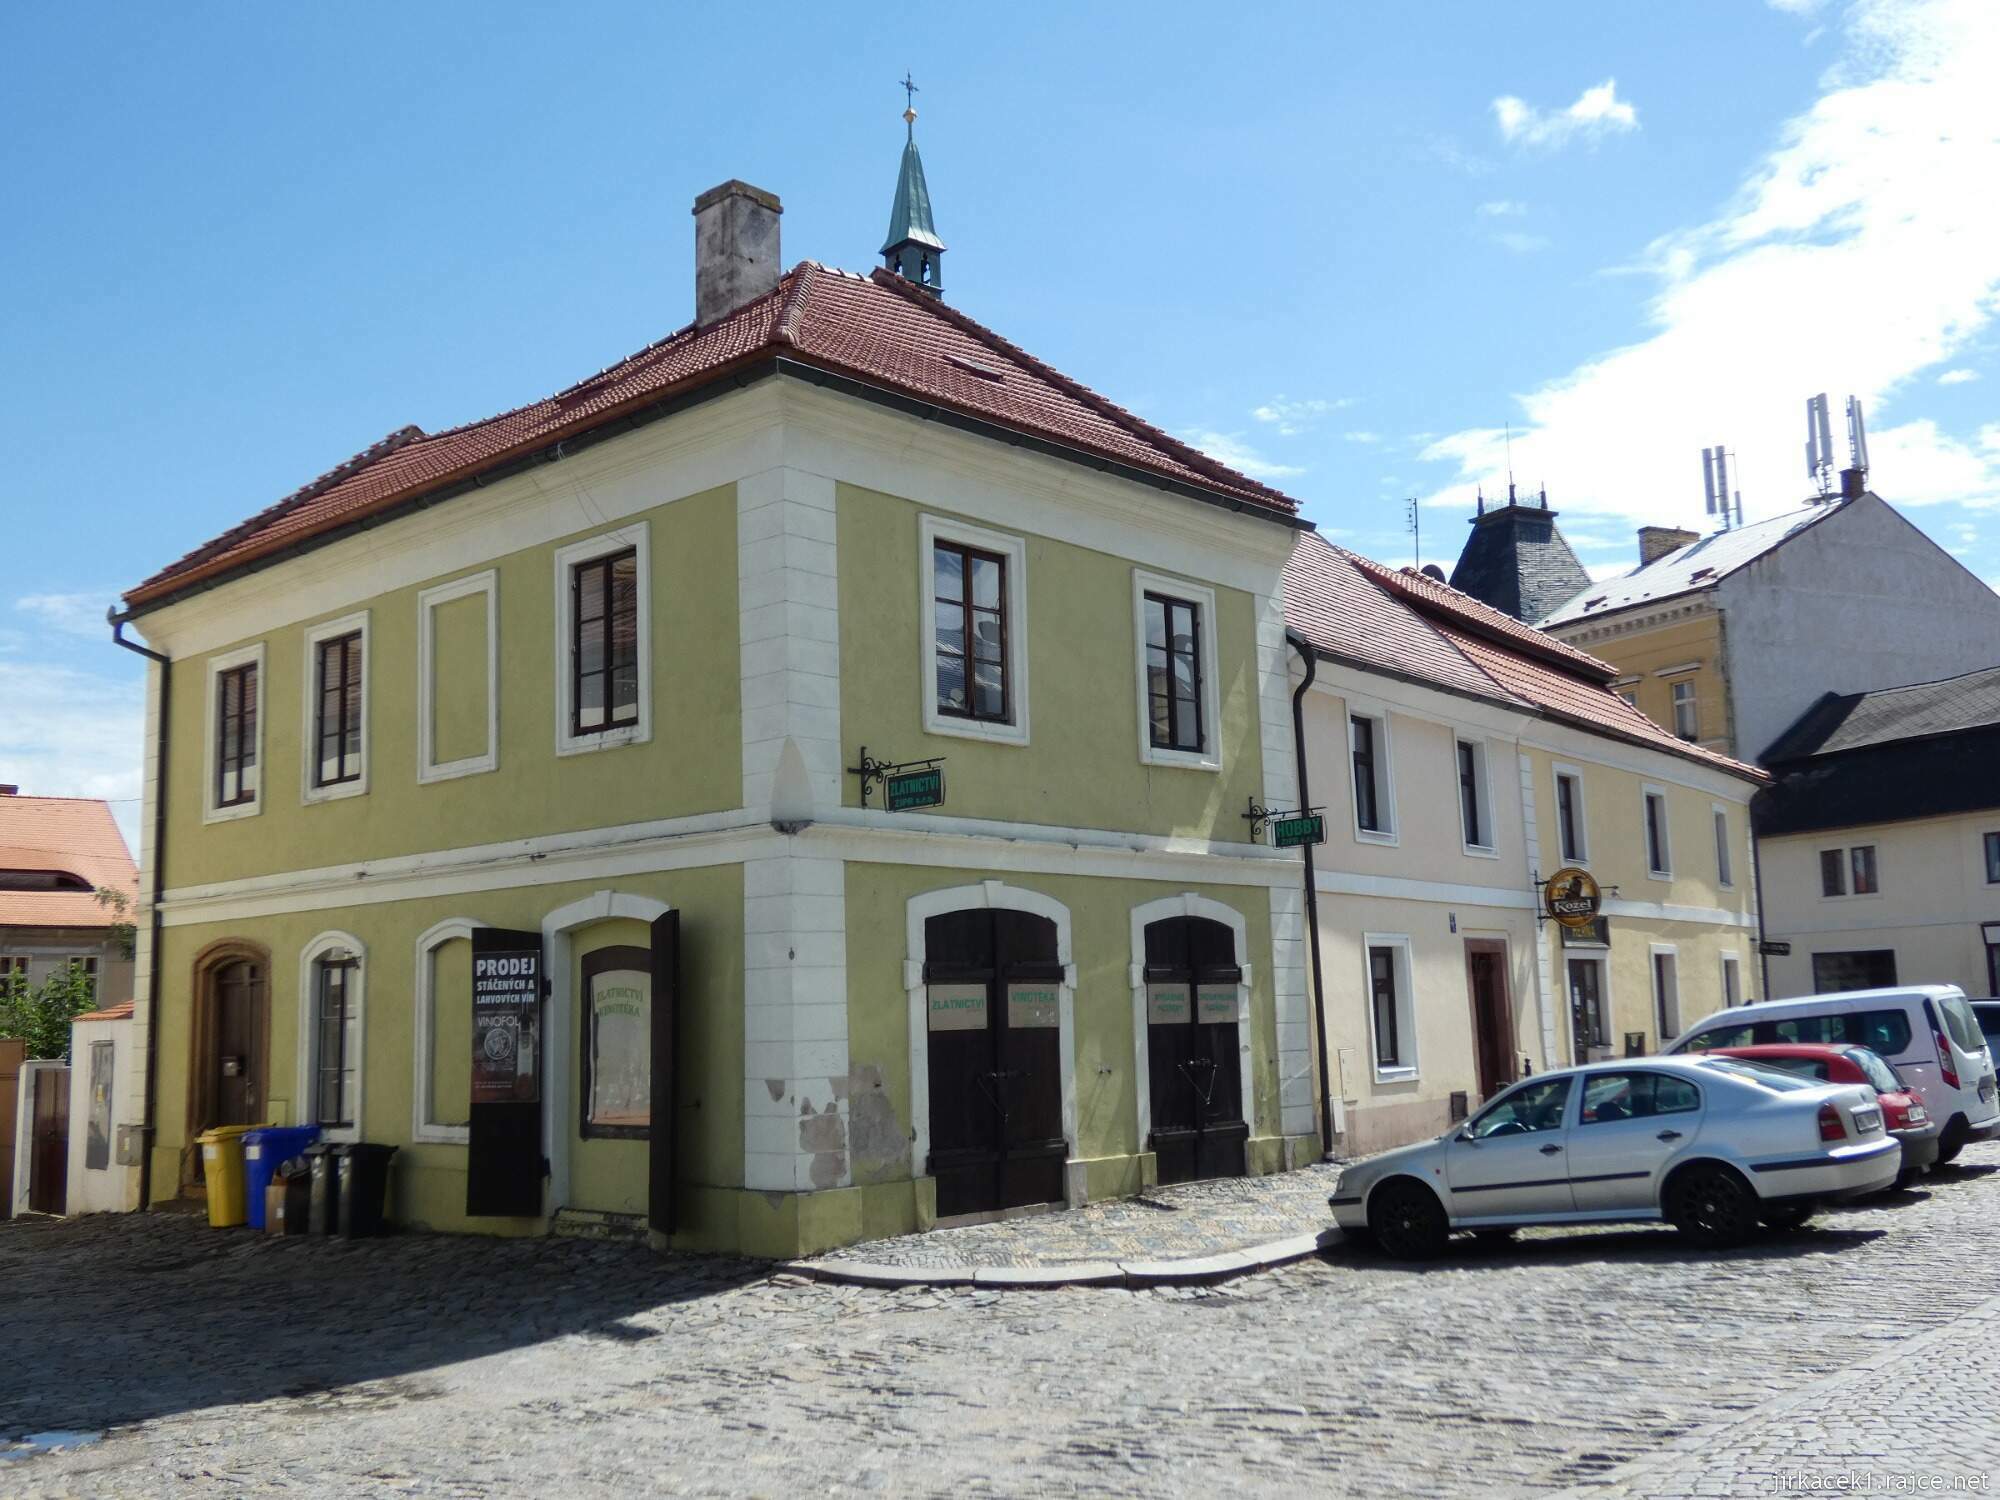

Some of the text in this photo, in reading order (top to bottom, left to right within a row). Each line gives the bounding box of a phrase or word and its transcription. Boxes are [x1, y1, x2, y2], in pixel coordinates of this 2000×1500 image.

[1276, 818, 1320, 837] HOBBY
[1554, 899, 1592, 913] Kozel
[476, 958, 536, 976] PRODEJ
[477, 978, 535, 992] STÁČENÝCH A
[477, 992, 535, 1004] LAHVOVÝCH VÍN
